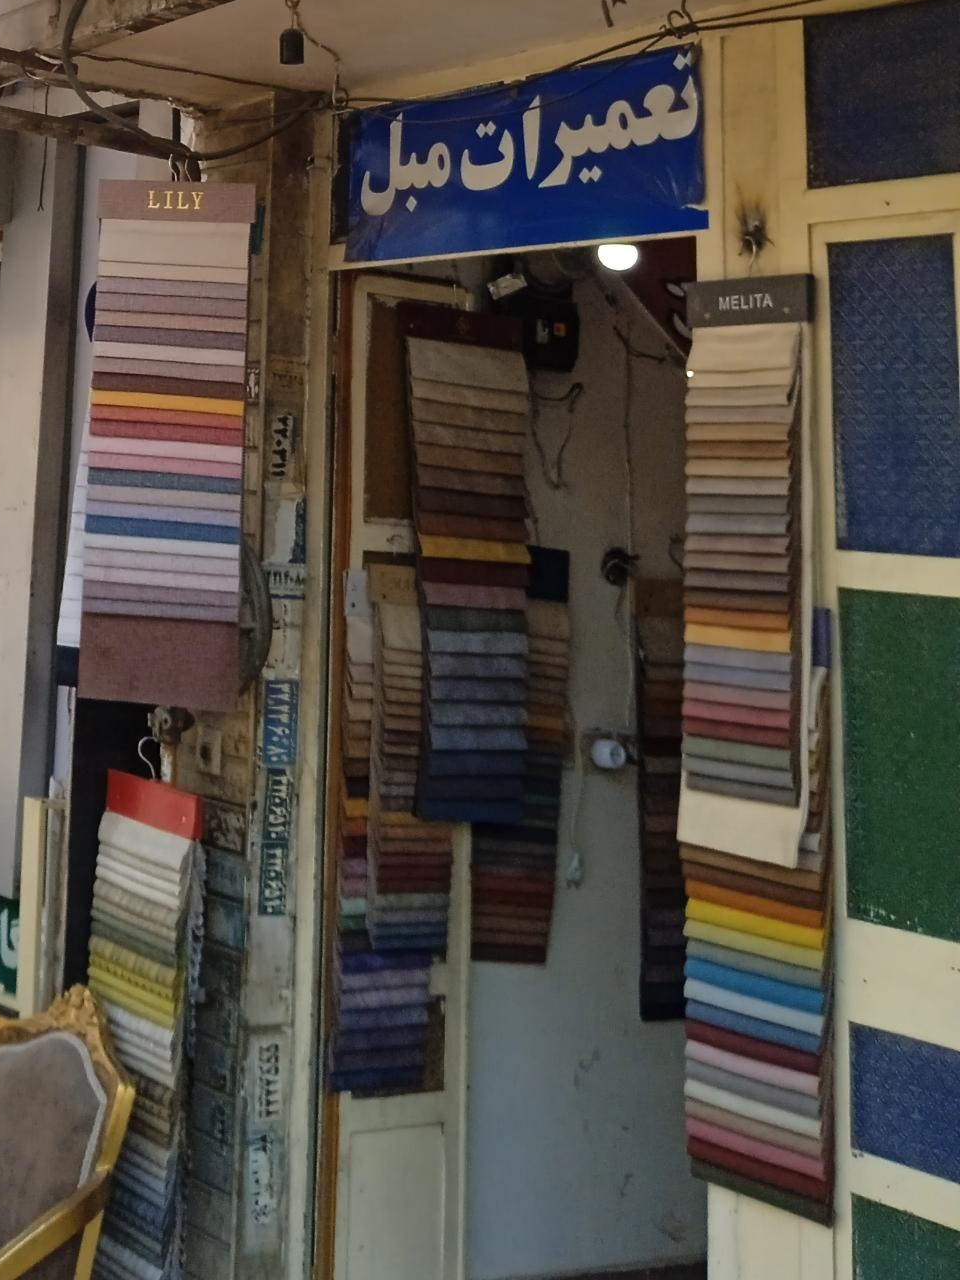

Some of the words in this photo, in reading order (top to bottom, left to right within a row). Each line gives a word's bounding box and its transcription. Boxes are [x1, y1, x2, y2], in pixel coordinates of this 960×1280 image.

[460, 50, 700, 191] تعمیرات
[359, 111, 452, 217] مبل
[147, 189, 205, 211] LILY
[718, 292, 774, 312] MELITA
